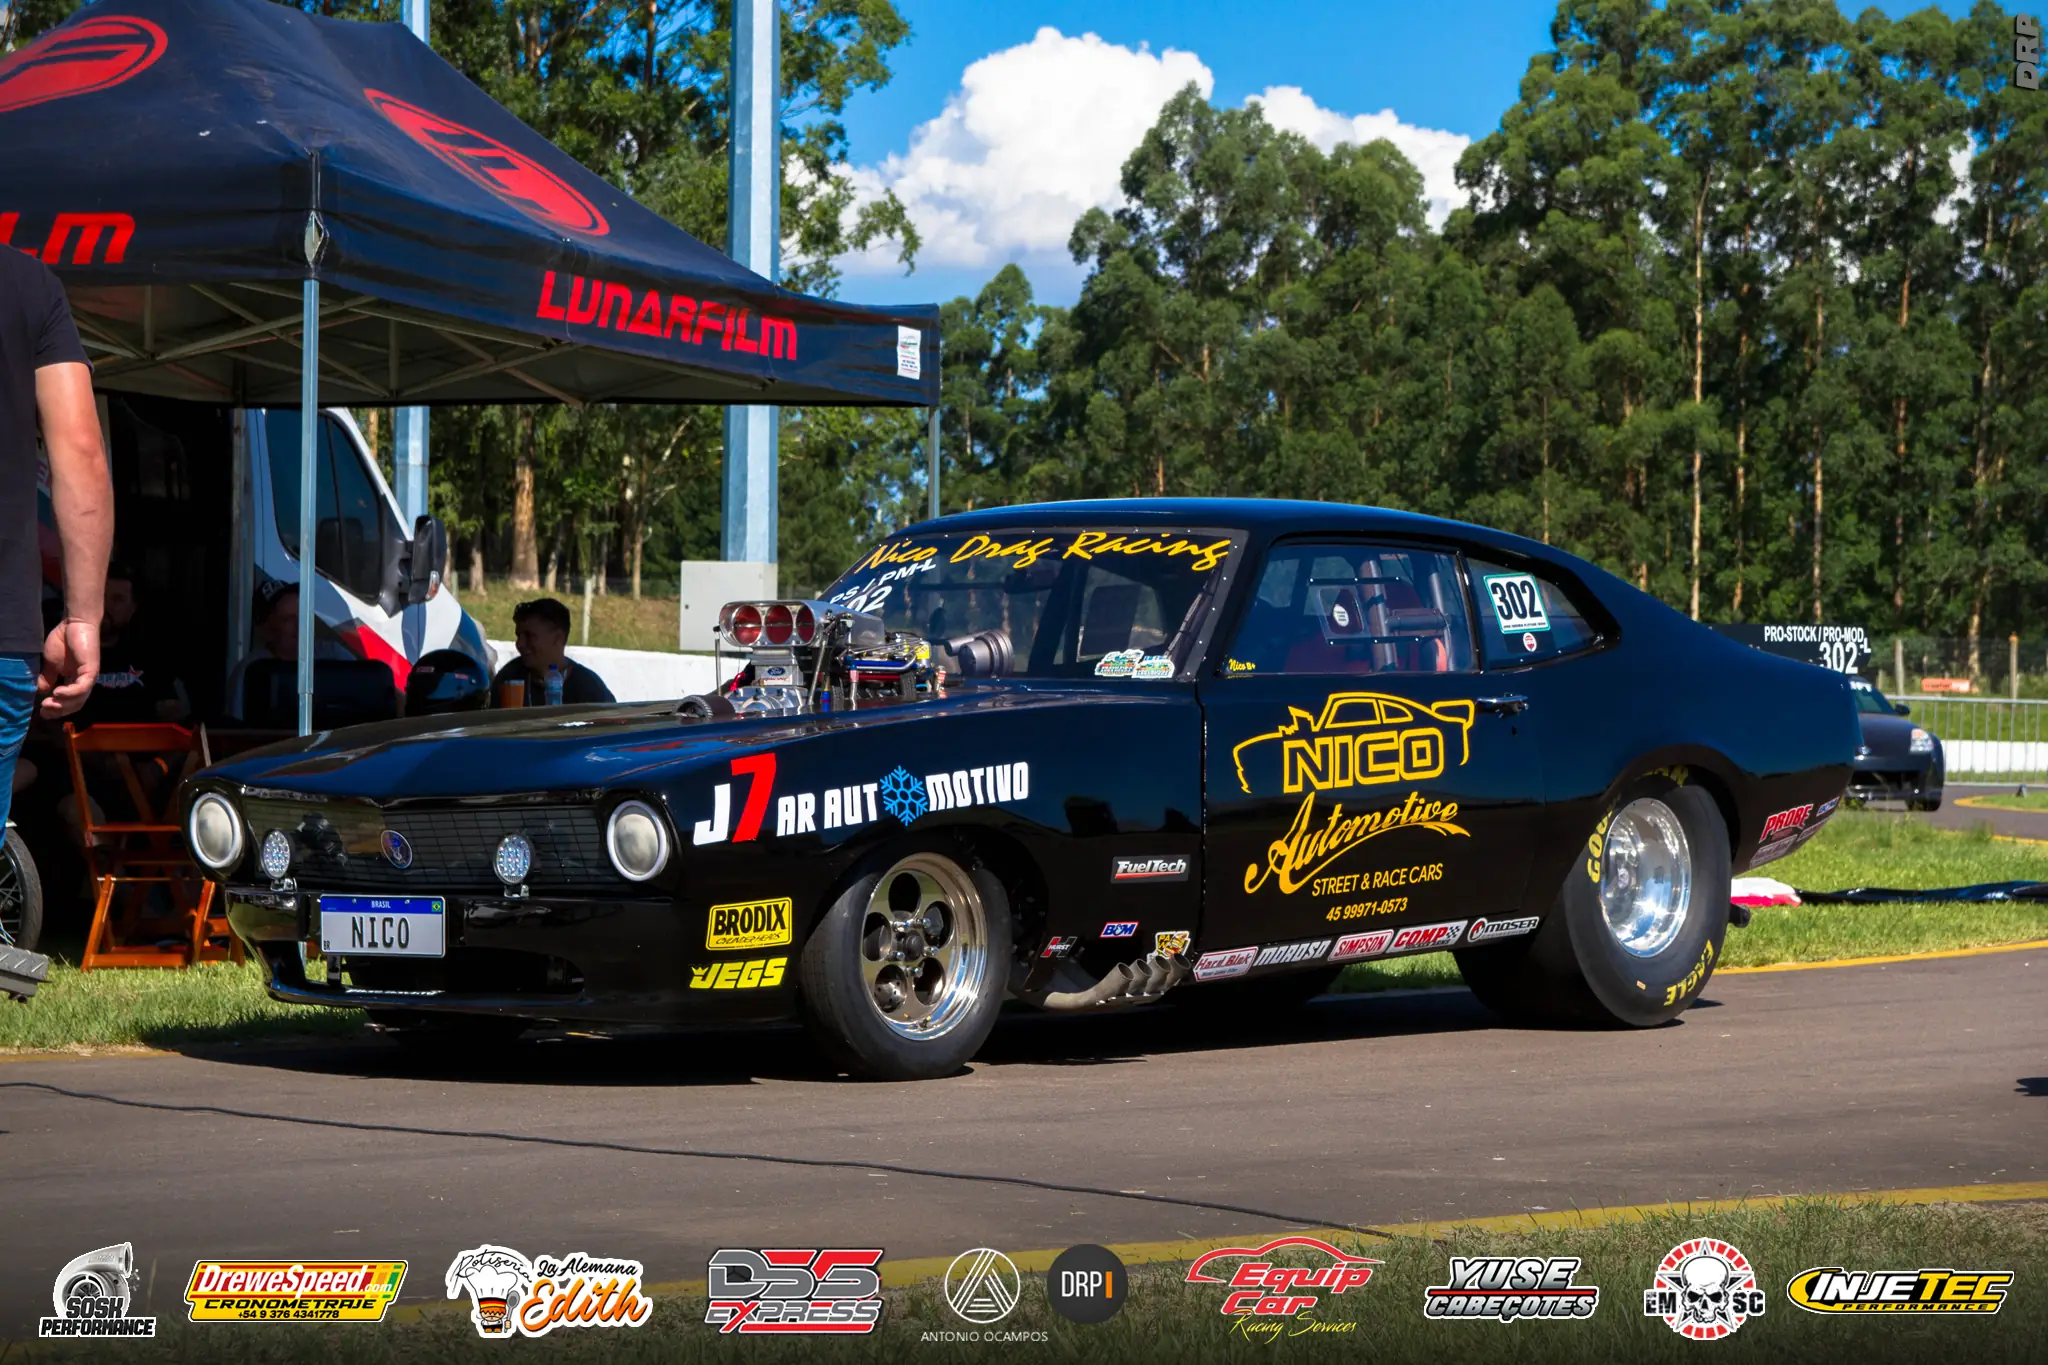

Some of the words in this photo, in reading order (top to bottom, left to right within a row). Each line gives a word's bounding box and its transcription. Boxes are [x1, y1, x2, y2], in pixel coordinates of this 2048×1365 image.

[536, 270, 798, 361] LUNARFILM
[854, 540, 938, 574] Nico
[950, 534, 1053, 569] Drag
[1062, 531, 1231, 572] Racing
[840, 585, 893, 613] 02
[1490, 580, 1543, 621] 302
[1764, 625, 1817, 642] PRO-STOCK
[1823, 626, 1864, 642] PRO-MOD
[1819, 641, 1858, 674] 302
[1283, 727, 1445, 794] NICO
[692, 752, 777, 846] J7
[777, 792, 817, 837] AR
[1759, 803, 1814, 843] PROBE
[1244, 791, 1460, 895] Automotive
[1117, 858, 1187, 874] FuelTech
[1312, 873, 1359, 897] STREET
[1360, 872, 1370, 890] &
[1372, 868, 1408, 889] RACE
[1408, 863, 1444, 884] CARS
[371, 900, 391, 909] BRASIL
[713, 902, 787, 936] BRODIX
[1326, 905, 1342, 921] 45
[1342, 897, 1409, 919] 99971-0573
[351, 915, 410, 949] NICO
[1334, 934, 1389, 957] SIMPSON
[1394, 926, 1449, 948] COMP
[689, 957, 788, 989] JEGS
